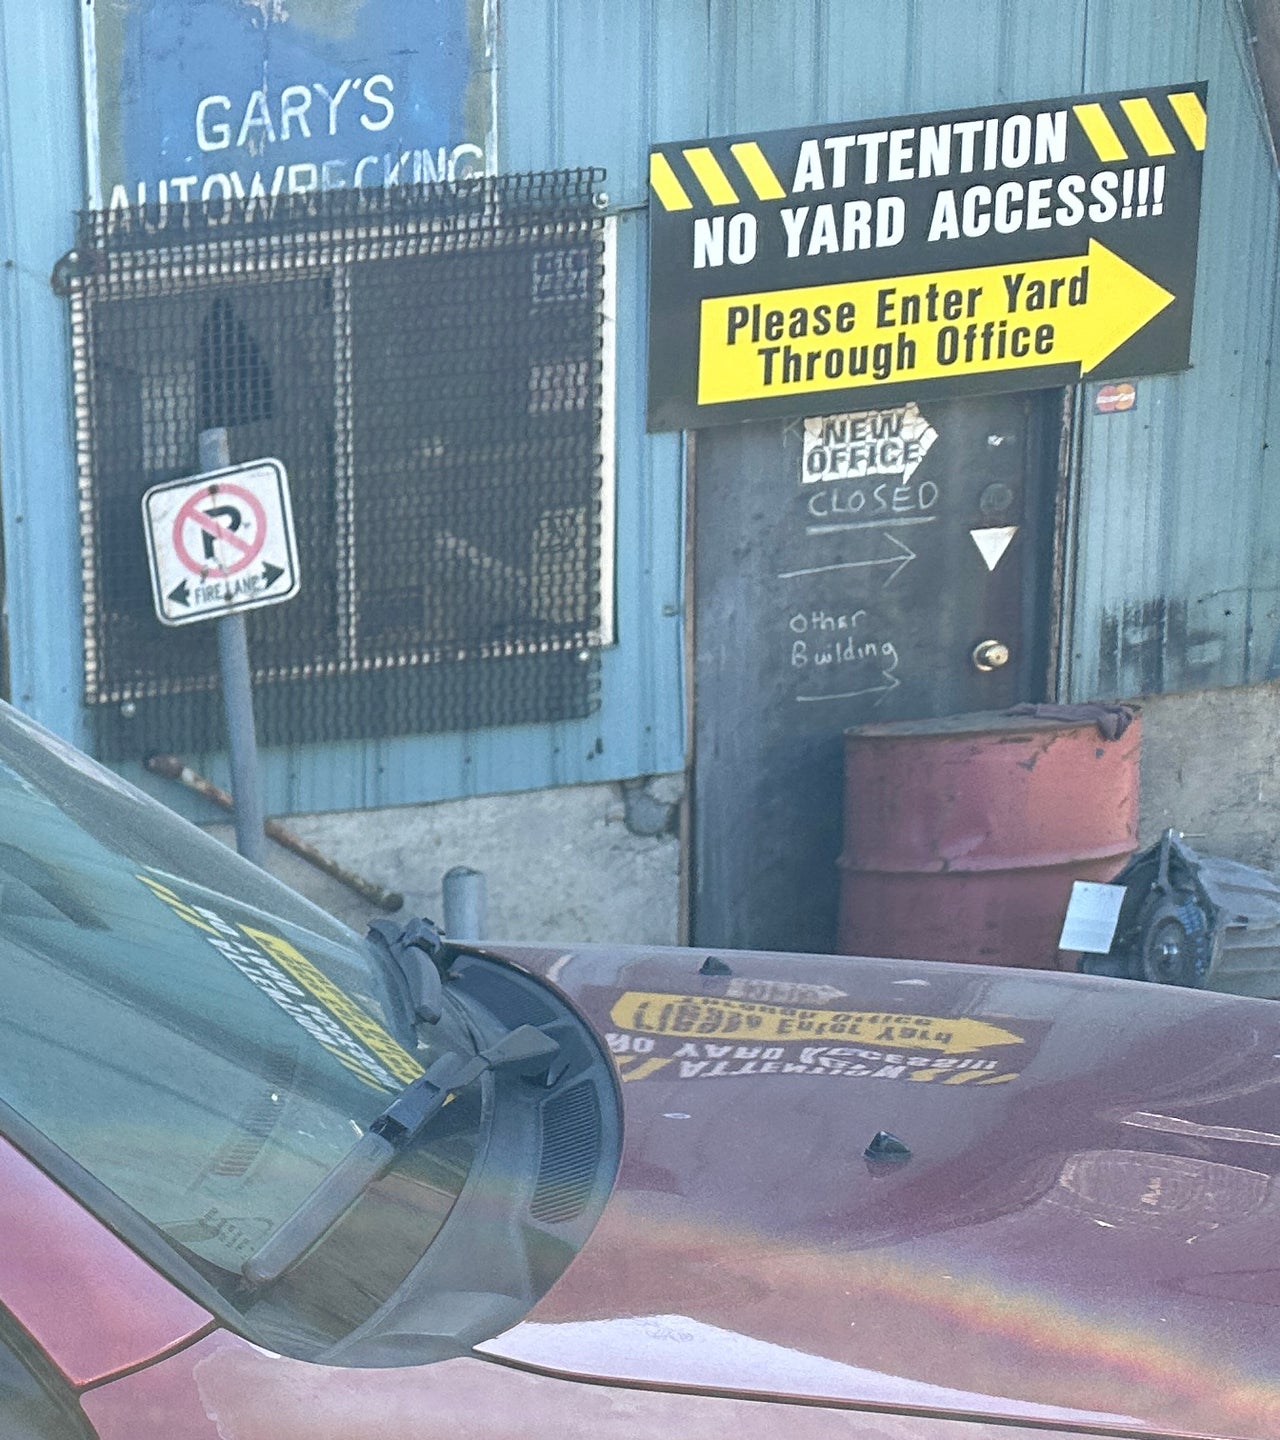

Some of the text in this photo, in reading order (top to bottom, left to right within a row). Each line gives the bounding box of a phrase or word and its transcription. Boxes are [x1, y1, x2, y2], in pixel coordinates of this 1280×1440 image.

[196, 74, 394, 151] GARY'S
[792, 110, 1067, 193] ATTENTION
[693, 165, 1166, 269] NO YARD ACCESS!!!
[726, 265, 1089, 345] Please Enter Yard
[758, 320, 1054, 386] Through Office
[823, 413, 904, 447] NEW
[807, 440, 921, 476] OFFICE
[808, 481, 938, 516] CLOSED
[194, 582, 222, 605] FIRE
[790, 609, 867, 633] Other
[792, 636, 899, 672] Building
